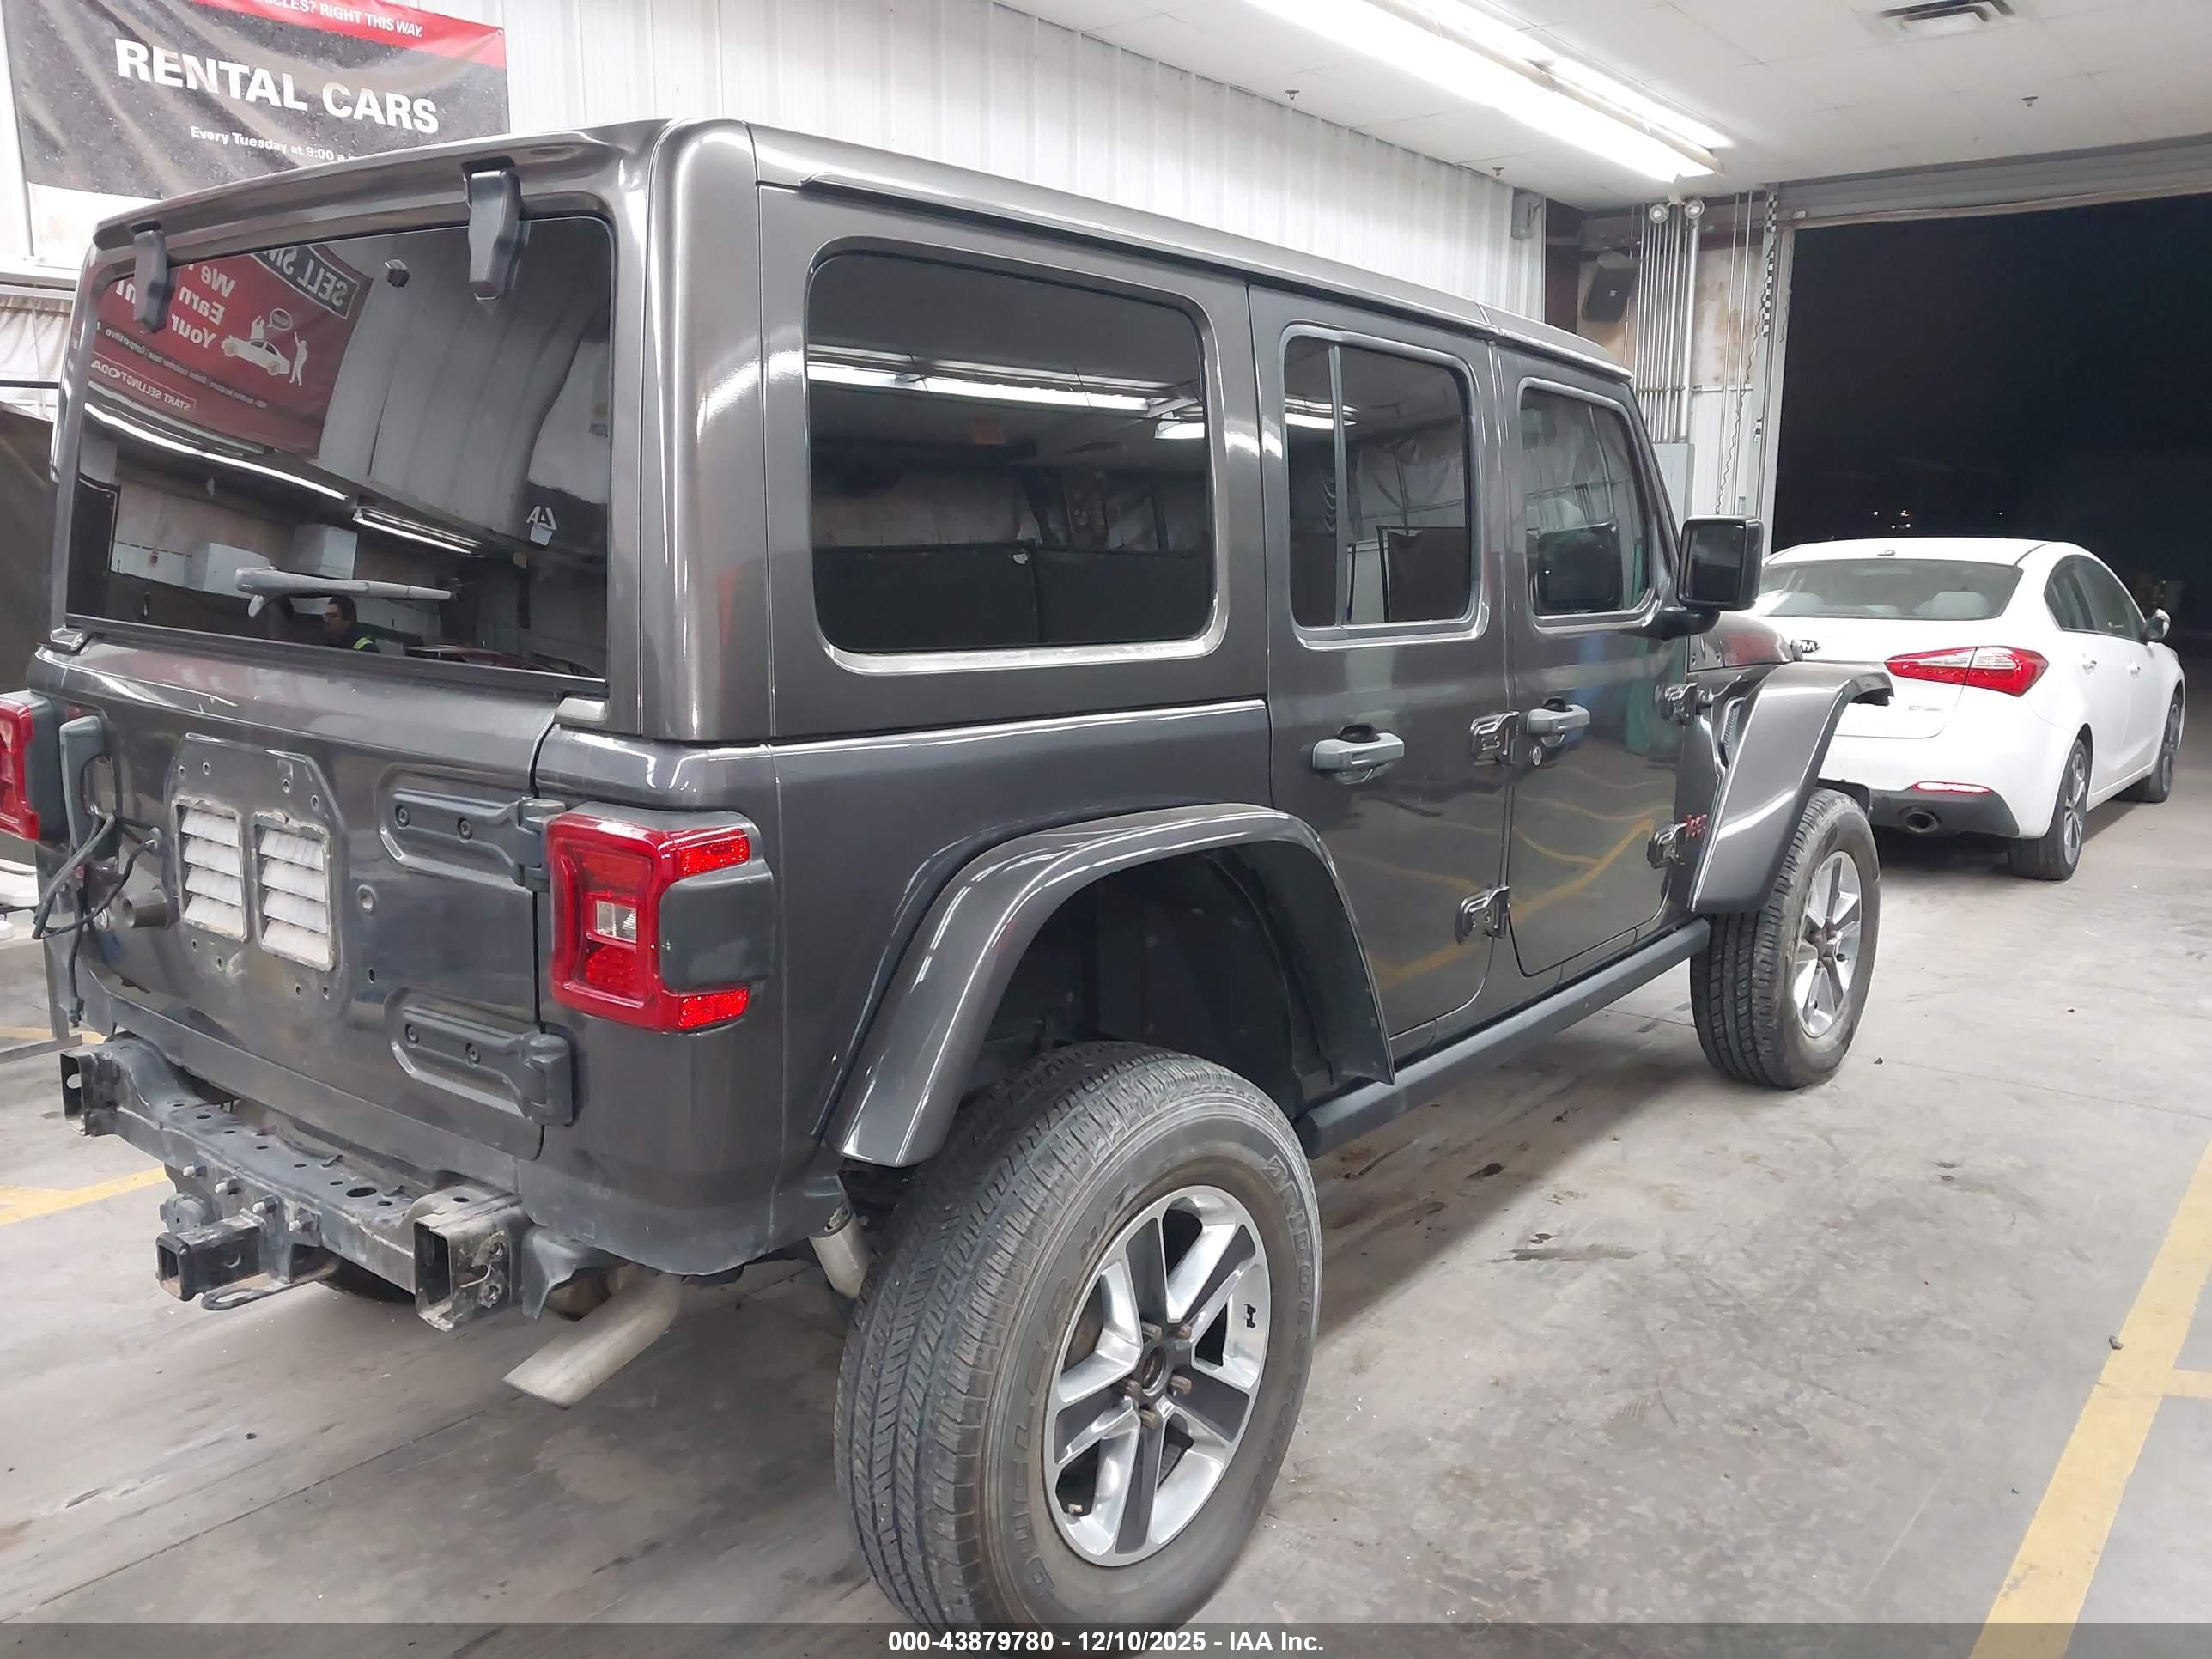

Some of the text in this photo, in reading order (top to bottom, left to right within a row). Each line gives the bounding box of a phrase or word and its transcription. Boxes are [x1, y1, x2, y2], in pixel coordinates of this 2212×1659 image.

[319, 3, 362, 24] RIGHT
[364, 13, 394, 31] THIS
[396, 21, 423, 38] WAY.
[114, 38, 441, 133] RENTAL CARS
[190, 125, 229, 145] Every
[232, 131, 287, 154] Tuesday
[290, 146, 304, 156] at
[306, 147, 334, 161] 9:00
